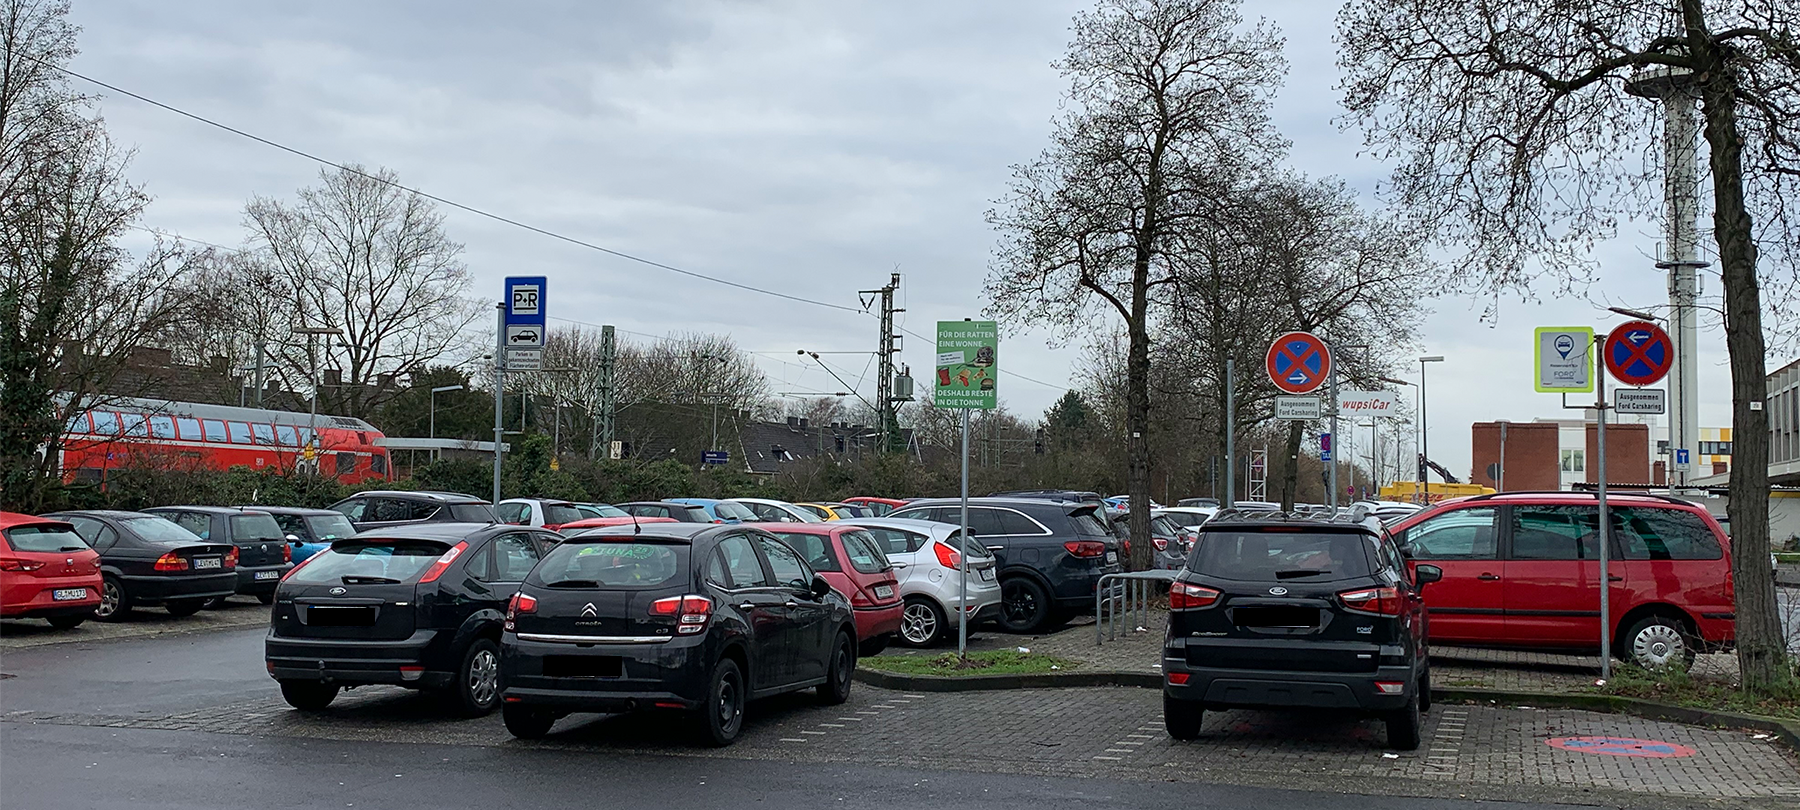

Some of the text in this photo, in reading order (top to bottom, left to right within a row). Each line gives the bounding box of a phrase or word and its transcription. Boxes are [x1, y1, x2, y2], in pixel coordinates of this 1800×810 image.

[513, 292, 538, 307] P+R
[1620, 393, 1659, 402] Ausgenommen
[1281, 400, 1316, 408] Ausgenommen
[1342, 398, 1391, 412] wupsiCar
[1632, 402, 1661, 411] Carsharing
[1292, 409, 1318, 417] Carsharing
